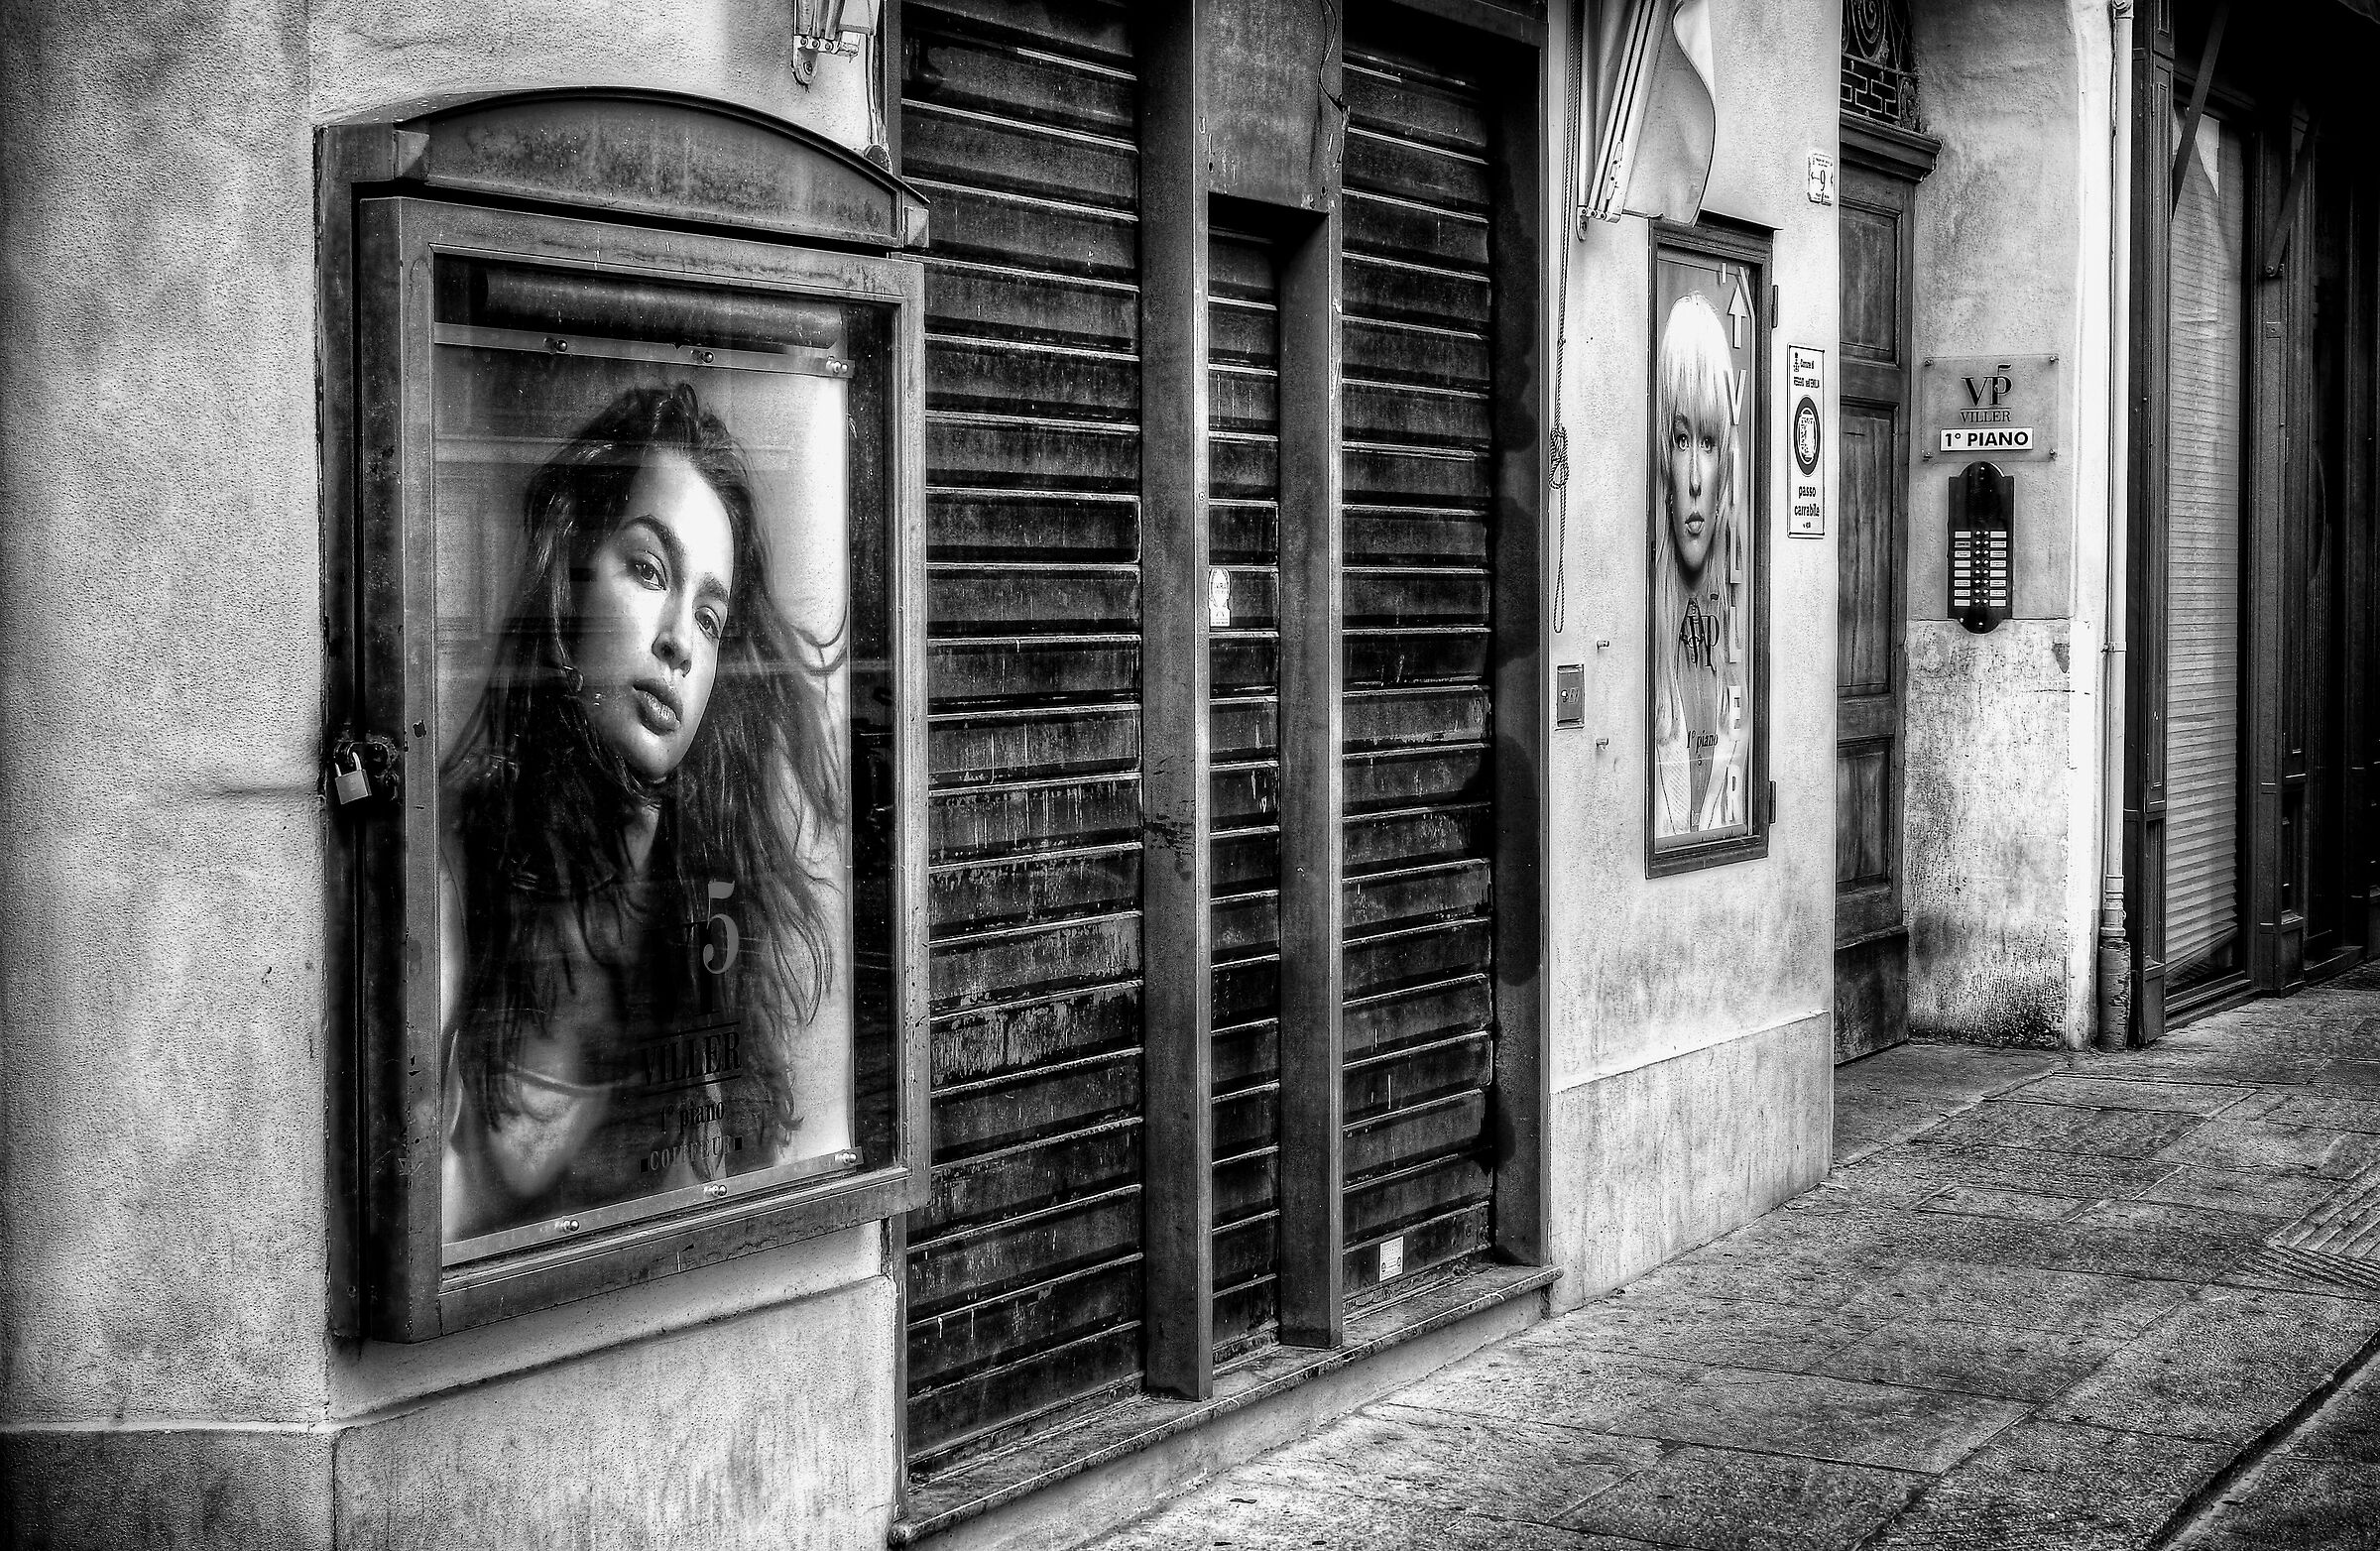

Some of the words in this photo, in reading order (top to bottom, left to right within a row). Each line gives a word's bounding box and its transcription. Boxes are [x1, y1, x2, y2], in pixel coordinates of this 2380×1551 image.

[1960, 411, 2012, 423] VILLER
[1945, 432, 1962, 447] 1°
[1966, 431, 2029, 446] PIANO
[1798, 486, 1817, 499] passo
[1794, 504, 1821, 517] carrabile
[1696, 729, 1719, 754] piano
[642, 1030, 742, 1088] VILLER
[678, 1100, 726, 1135] piano
